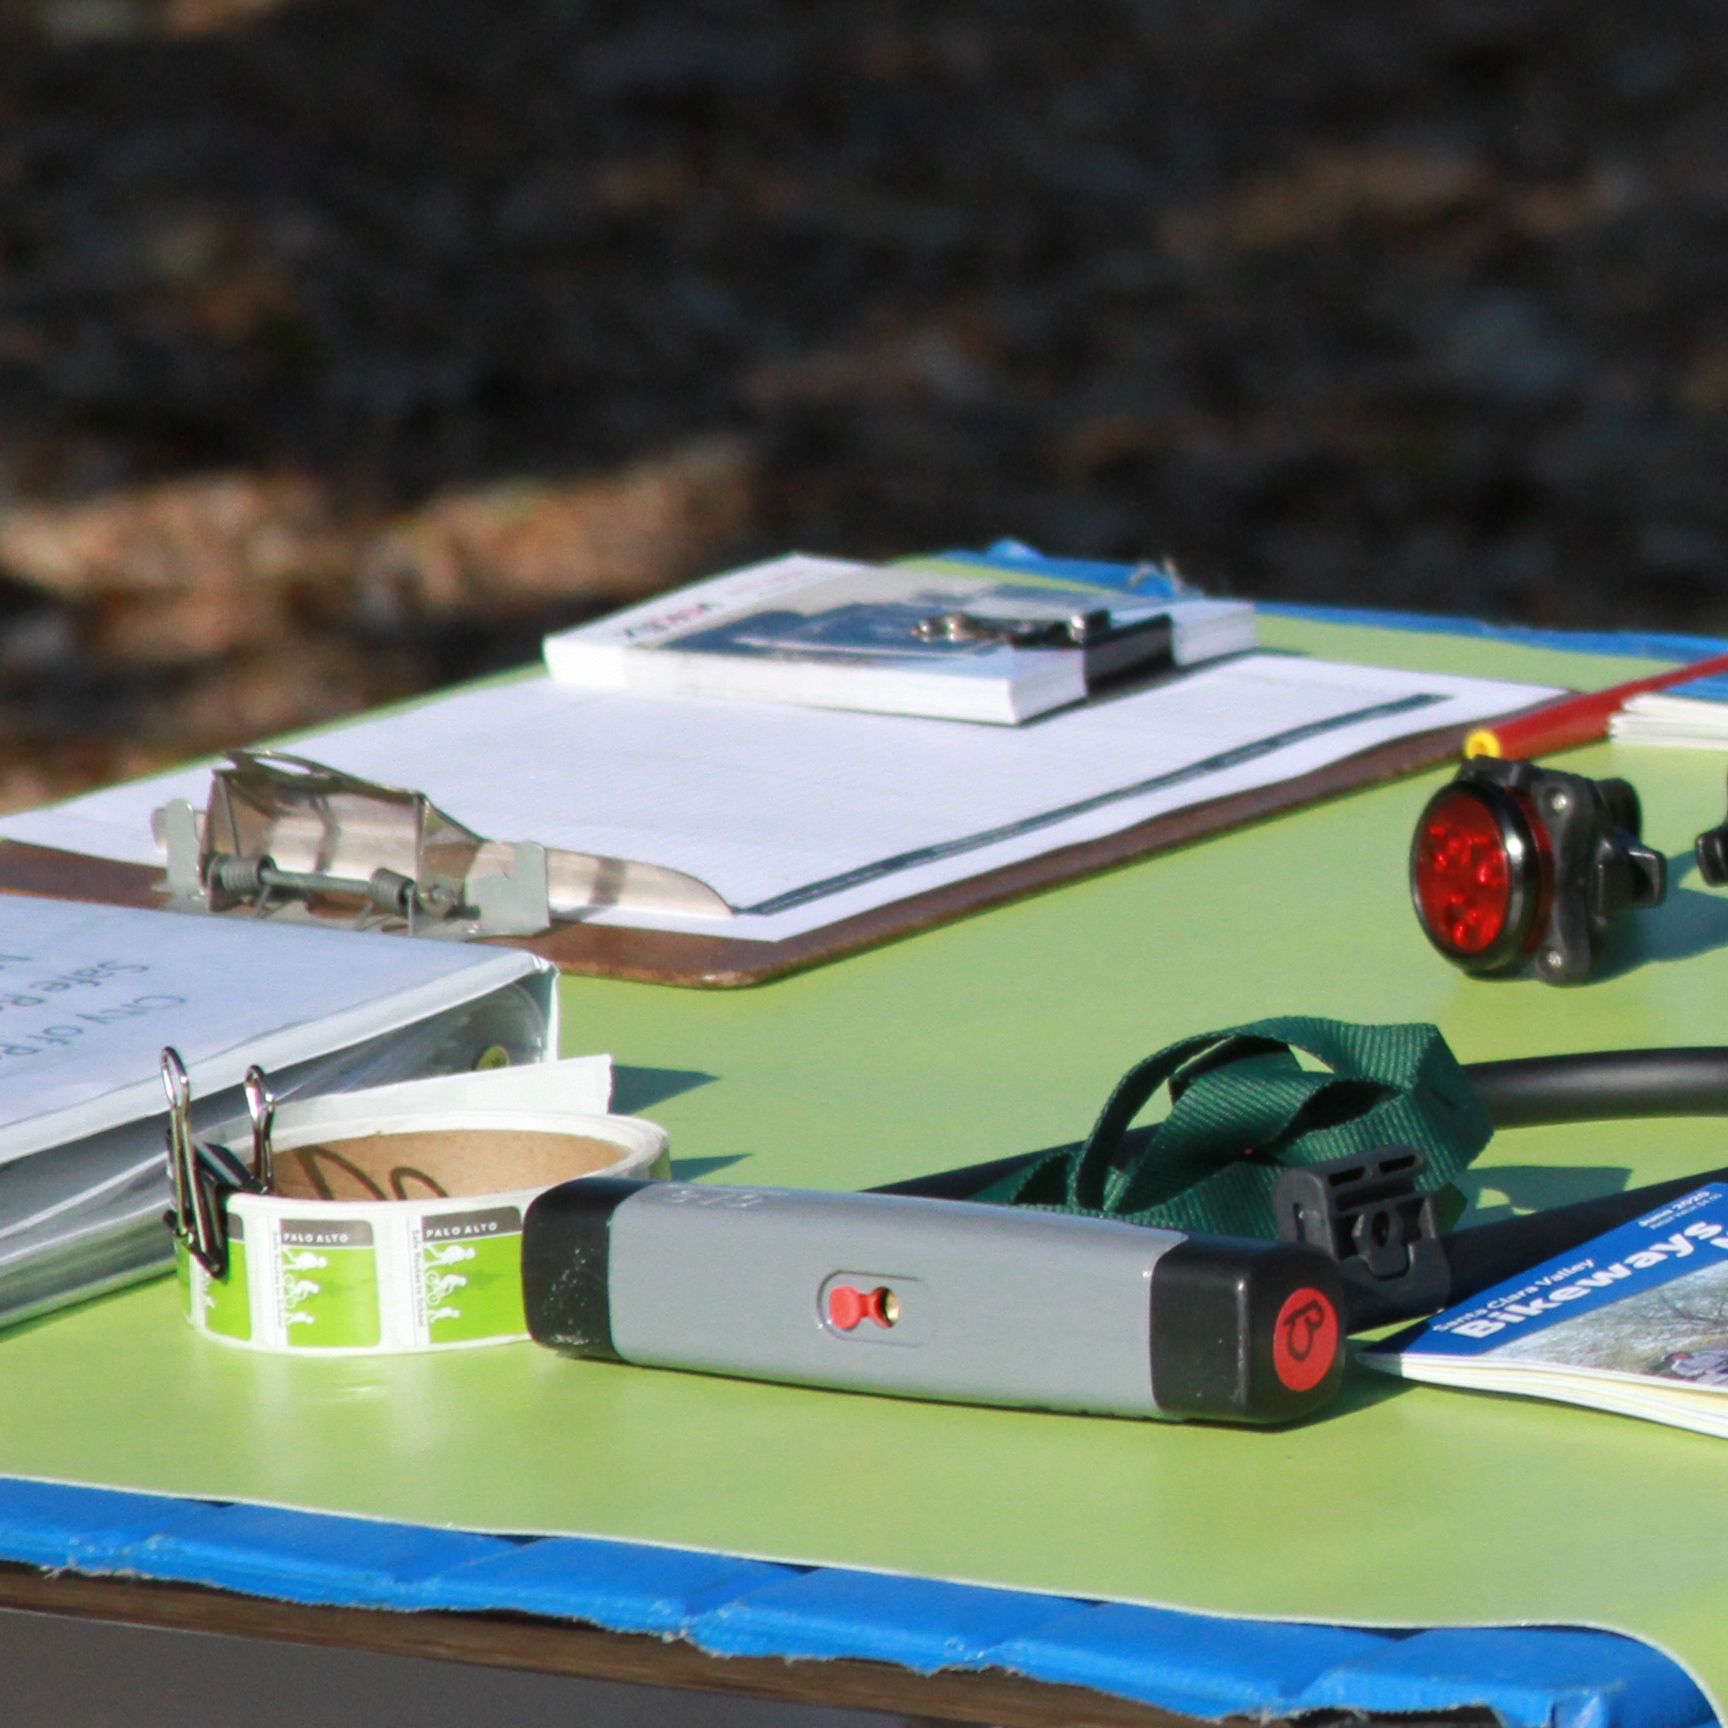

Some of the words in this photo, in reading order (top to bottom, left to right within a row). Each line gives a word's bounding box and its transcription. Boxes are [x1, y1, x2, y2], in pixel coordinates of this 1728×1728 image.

[1638, 1209, 1674, 1228] June
[1671, 1190, 1712, 1211] 2020
[283, 1233, 313, 1244] PALO
[316, 1233, 349, 1244] ALTO
[426, 1225, 461, 1239] PALO
[464, 1221, 498, 1235] ALTO
[1433, 1306, 1489, 1333] Santa
[1487, 1283, 1540, 1311] Clara
[1535, 1258, 1597, 1288] Valley
[1451, 1219, 1724, 1340] Bikeways
